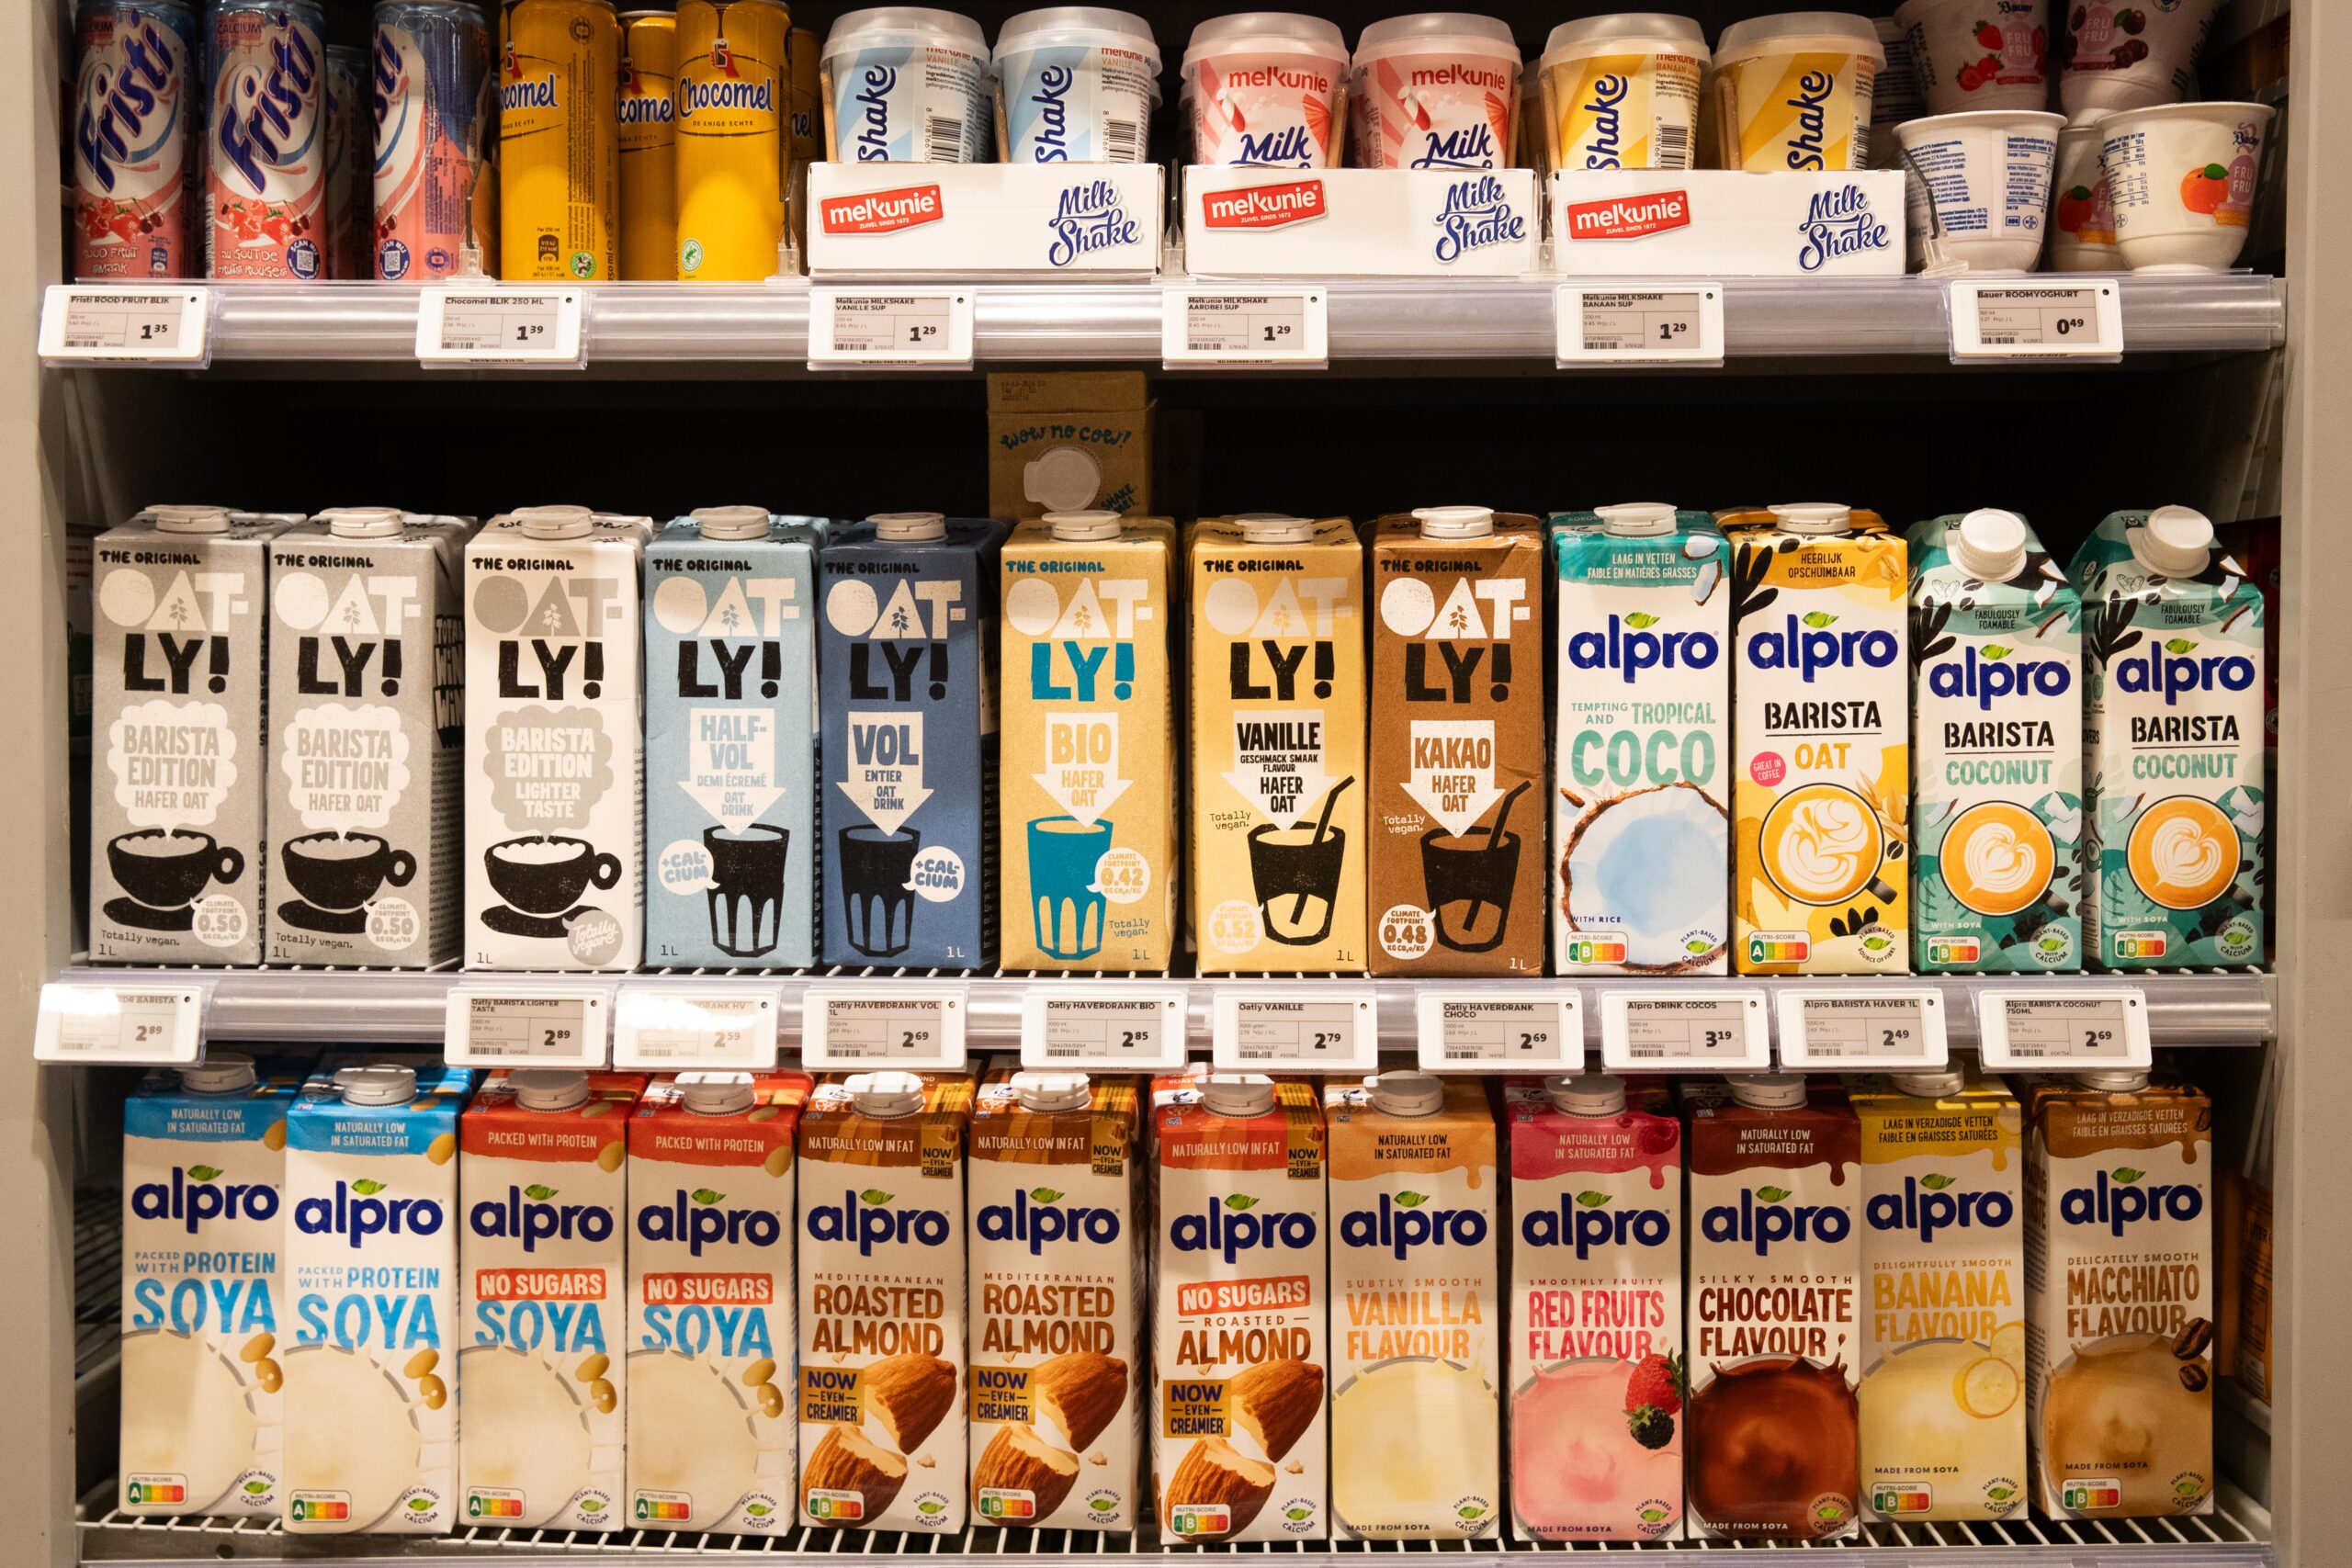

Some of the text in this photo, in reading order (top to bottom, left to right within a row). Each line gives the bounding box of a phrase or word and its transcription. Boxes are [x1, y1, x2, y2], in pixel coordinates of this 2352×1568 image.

[1228, 65, 1329, 94] melkunie
[79, 7, 175, 193] Fristi
[219, 11, 319, 195] Fristi
[679, 76, 774, 118] Chocomel
[2233, 166, 2252, 179] FRU
[2233, 180, 2252, 192] FRU
[830, 195, 935, 225] melkunie
[1049, 181, 1118, 227] Milk
[1438, 177, 1505, 220] Milk
[859, 220, 879, 229] ZUIVEL
[1577, 198, 1682, 231] melkunie
[1049, 209, 1138, 266] Shake
[1436, 208, 1526, 261] Shake
[99, 551, 200, 565] THE ORIGINAL
[1612, 553, 1676, 564] LAAG IN VETTEN
[1801, 553, 1841, 565] HEERLIJK
[1588, 565, 1697, 579] FAIBLE EN MATIÈRES GRASSES
[1788, 567, 1855, 579] OPSCHUIMBAAR
[1975, 609, 2019, 620] FABULOUSLY
[1979, 620, 2016, 629] FOAMABLE
[1568, 614, 1719, 683] alpro
[123, 633, 230, 694] LY!
[2116, 640, 2256, 705] alpro
[1632, 702, 1716, 724] TROPICAL
[1765, 702, 1883, 729] BARISTA
[123, 725, 220, 755] BARISTA
[700, 716, 766, 741] HALF-
[1237, 723, 1320, 750] VANILLE
[1051, 724, 1111, 764] BIO
[1414, 738, 1491, 770] KAKAO
[709, 744, 752, 770] VOL
[1240, 754, 1317, 763] GESCHMACK SMAAK
[1263, 763, 1295, 773] FLAVOUR
[1571, 730, 1716, 787] COCO
[1753, 761, 1773, 772] GREAT
[1794, 743, 1851, 770] OAT
[128, 758, 215, 787] EDITION
[697, 773, 766, 787] DEMI ÉCREMÉ
[865, 771, 901, 782] ENTIER
[1758, 769, 1781, 780] COFFEE
[1946, 760, 2052, 785] COCONUT
[135, 792, 209, 809] HAFER OAT
[664, 866, 709, 883] CIUM
[101, 930, 180, 946] Totally vegan.
[371, 917, 414, 936] 0.50
[1383, 924, 1427, 944] 0.48
[1680, 930, 1717, 943] PLANT-BASED
[829, 1002, 853, 1010] Oatly
[1239, 1004, 1262, 1012] Oatly
[1628, 1002, 1652, 1010] Alpro
[172, 1109, 242, 1120] NATURALLY LOW
[167, 1122, 245, 1134] IN SATURATED FAT
[488, 1132, 596, 1147] PACKED WITH PROTEIN
[2073, 1124, 2096, 1137] FAIBLE
[2098, 1125, 2109, 1136] EN
[2111, 1124, 2148, 1136] GRAISSES
[1288, 1149, 1317, 1159] NOW
[131, 1166, 279, 1234] alpro
[2060, 1169, 2203, 1237] alpro
[1874, 1259, 1956, 1269] DELIGHTFULLY
[481, 1273, 602, 1296] NO SUGARS
[815, 1273, 944, 1285] MEDITERRANEAN
[1347, 1278, 1482, 1288] SUBTLY SMOOTH
[1874, 1269, 2012, 1310] BANANA
[2067, 1264, 2199, 1305] MACCHIATO
[814, 1284, 944, 1319] ROASTED
[1346, 1291, 1482, 1326] VANILLA
[1529, 1290, 1665, 1327] RED FRUITS
[1700, 1288, 1852, 1322] CHOCOLATE
[296, 1293, 441, 1349] SOYA
[982, 1319, 1114, 1356] ALMOND
[1700, 1326, 1826, 1357] FLAVOUR
[1185, 1404, 1210, 1416] EVEN
